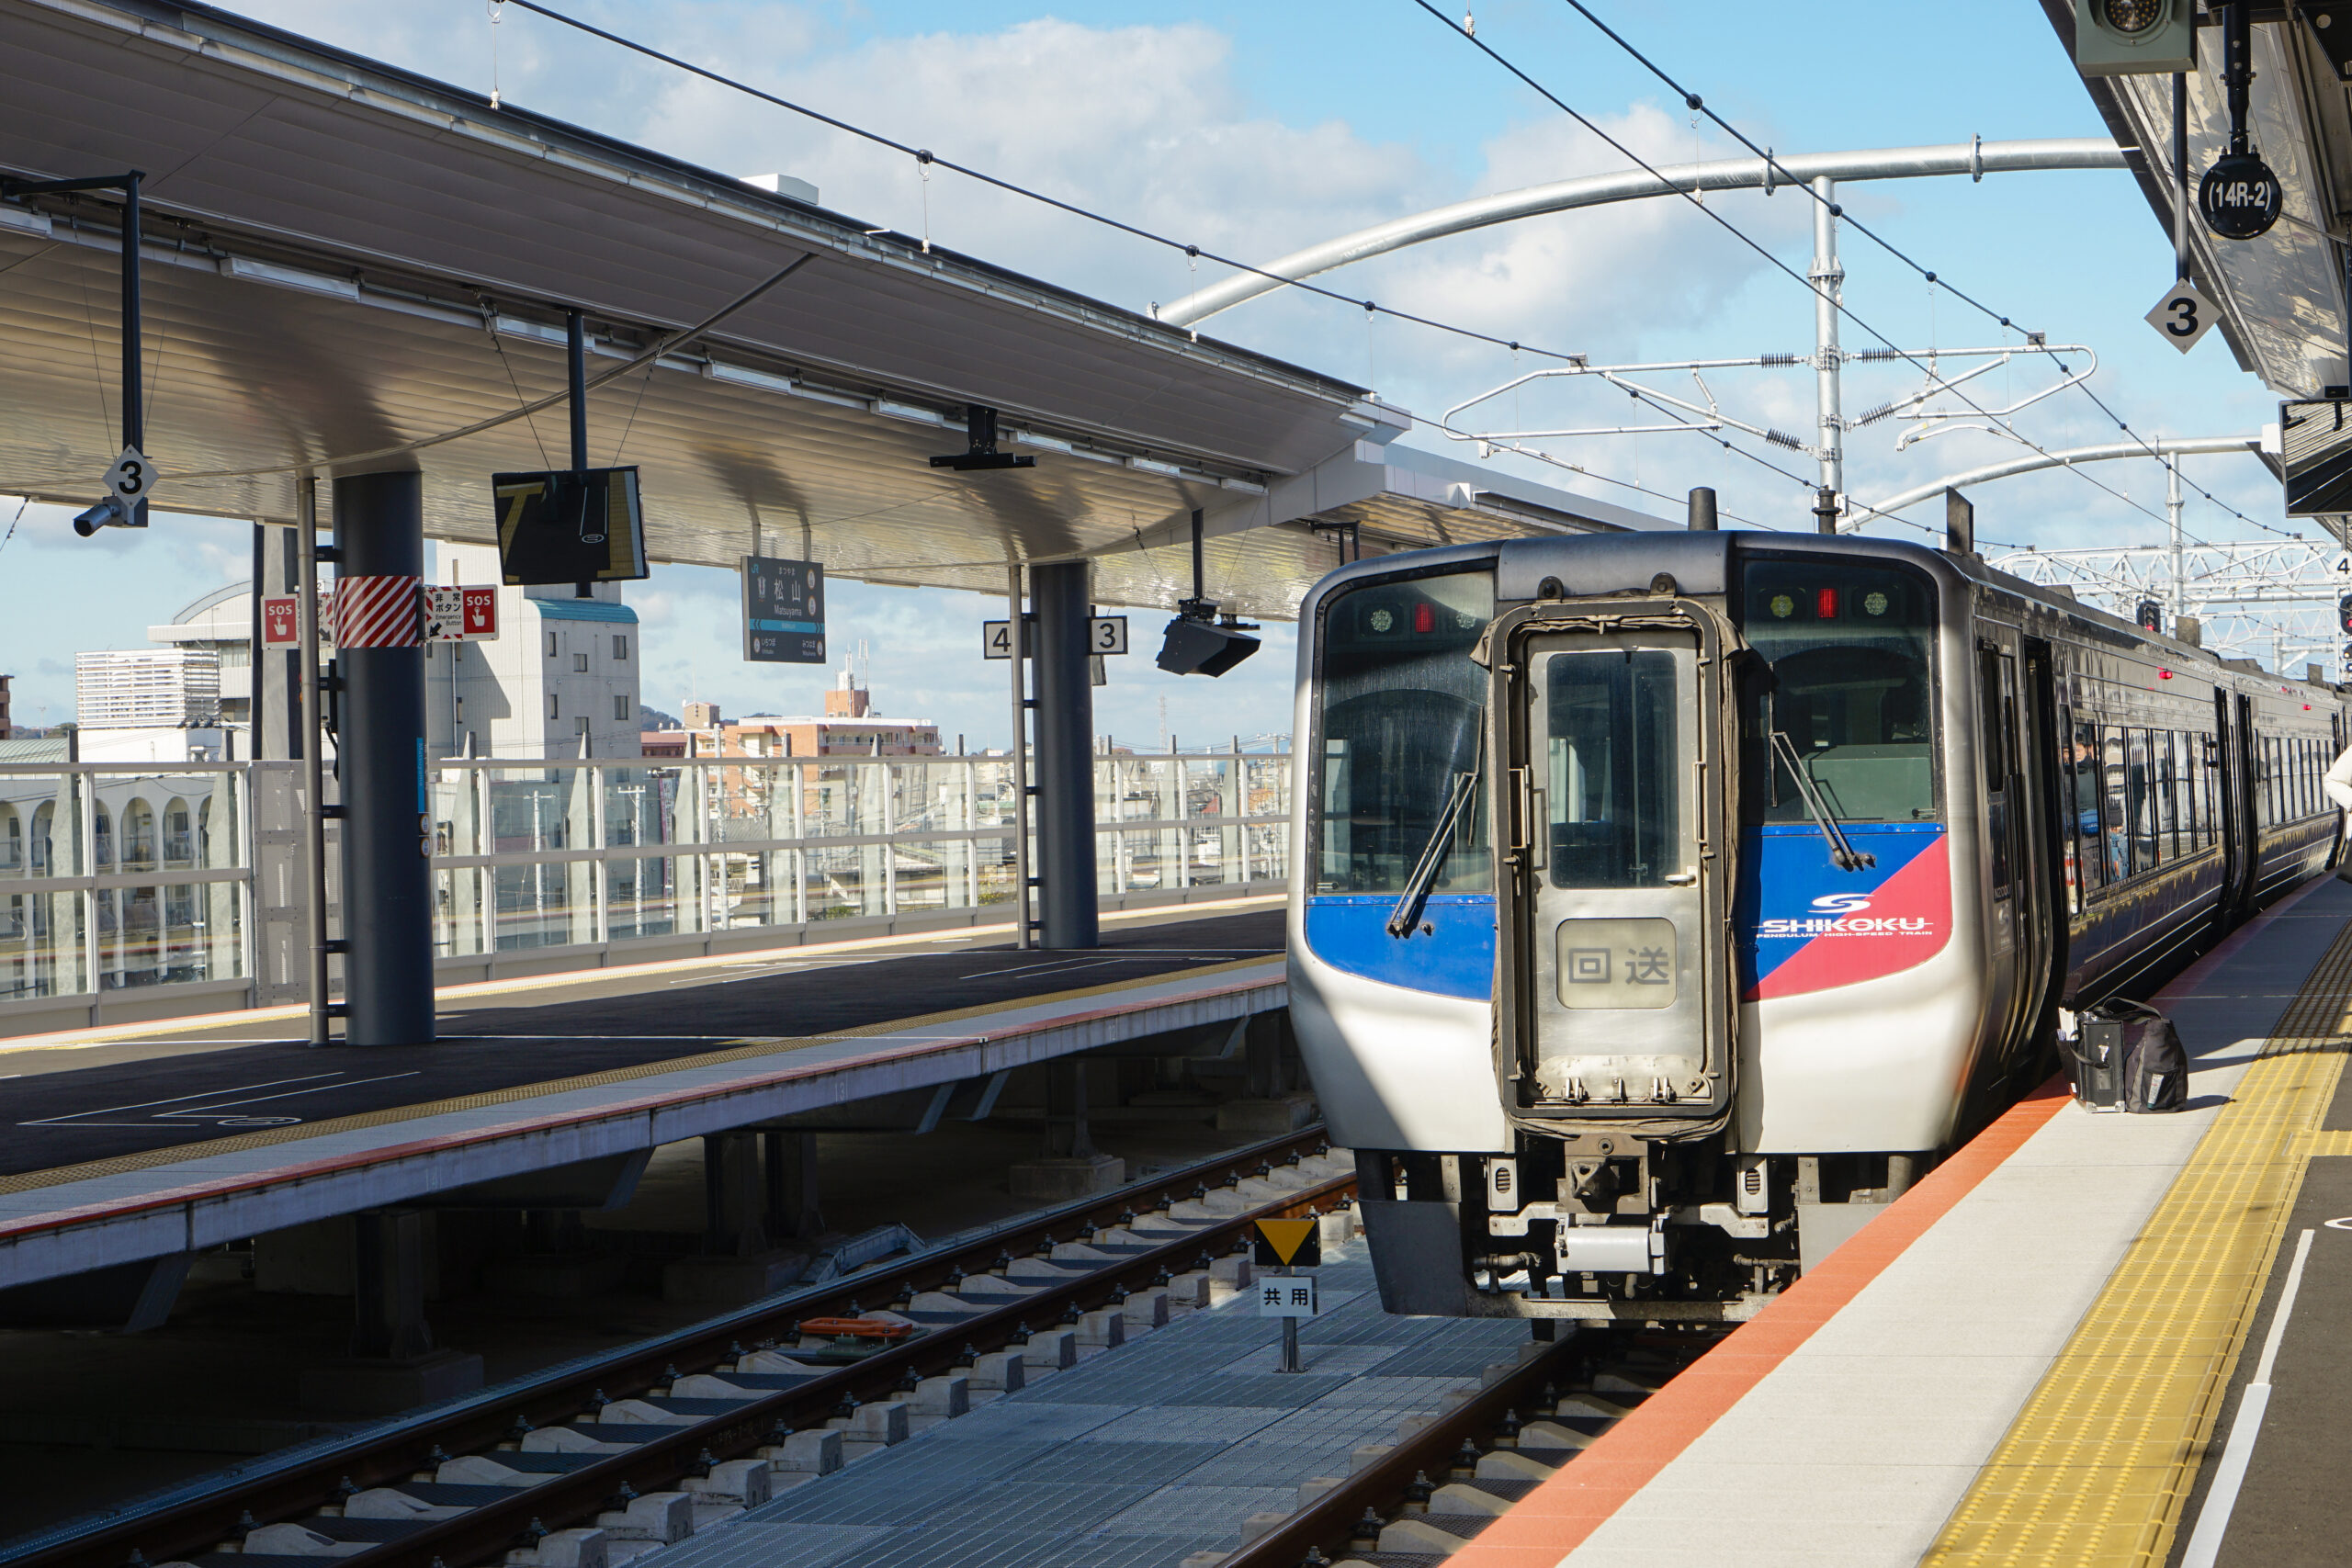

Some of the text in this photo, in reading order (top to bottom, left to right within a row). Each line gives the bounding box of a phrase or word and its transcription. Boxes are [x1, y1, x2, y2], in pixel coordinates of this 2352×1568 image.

[2209, 181, 2271, 212] (14R-2)
[2166, 297, 2199, 337] 3
[119, 460, 142, 495] 3
[751, 563, 759, 574] JR
[2336, 558, 2351, 575] 4
[435, 592, 461, 603] 非常
[774, 578, 801, 603] 松山
[435, 603, 461, 613] ボタン
[466, 595, 491, 606] SOS
[268, 604, 293, 616] SOS
[774, 604, 802, 618] Matsuyama
[992, 627, 1011, 652] 4
[1099, 623, 1116, 649] 3
[1761, 917, 1926, 933] SHIKOKU
[1568, 946, 1670, 985] 回送
[1263, 1287, 1308, 1305] 共用
